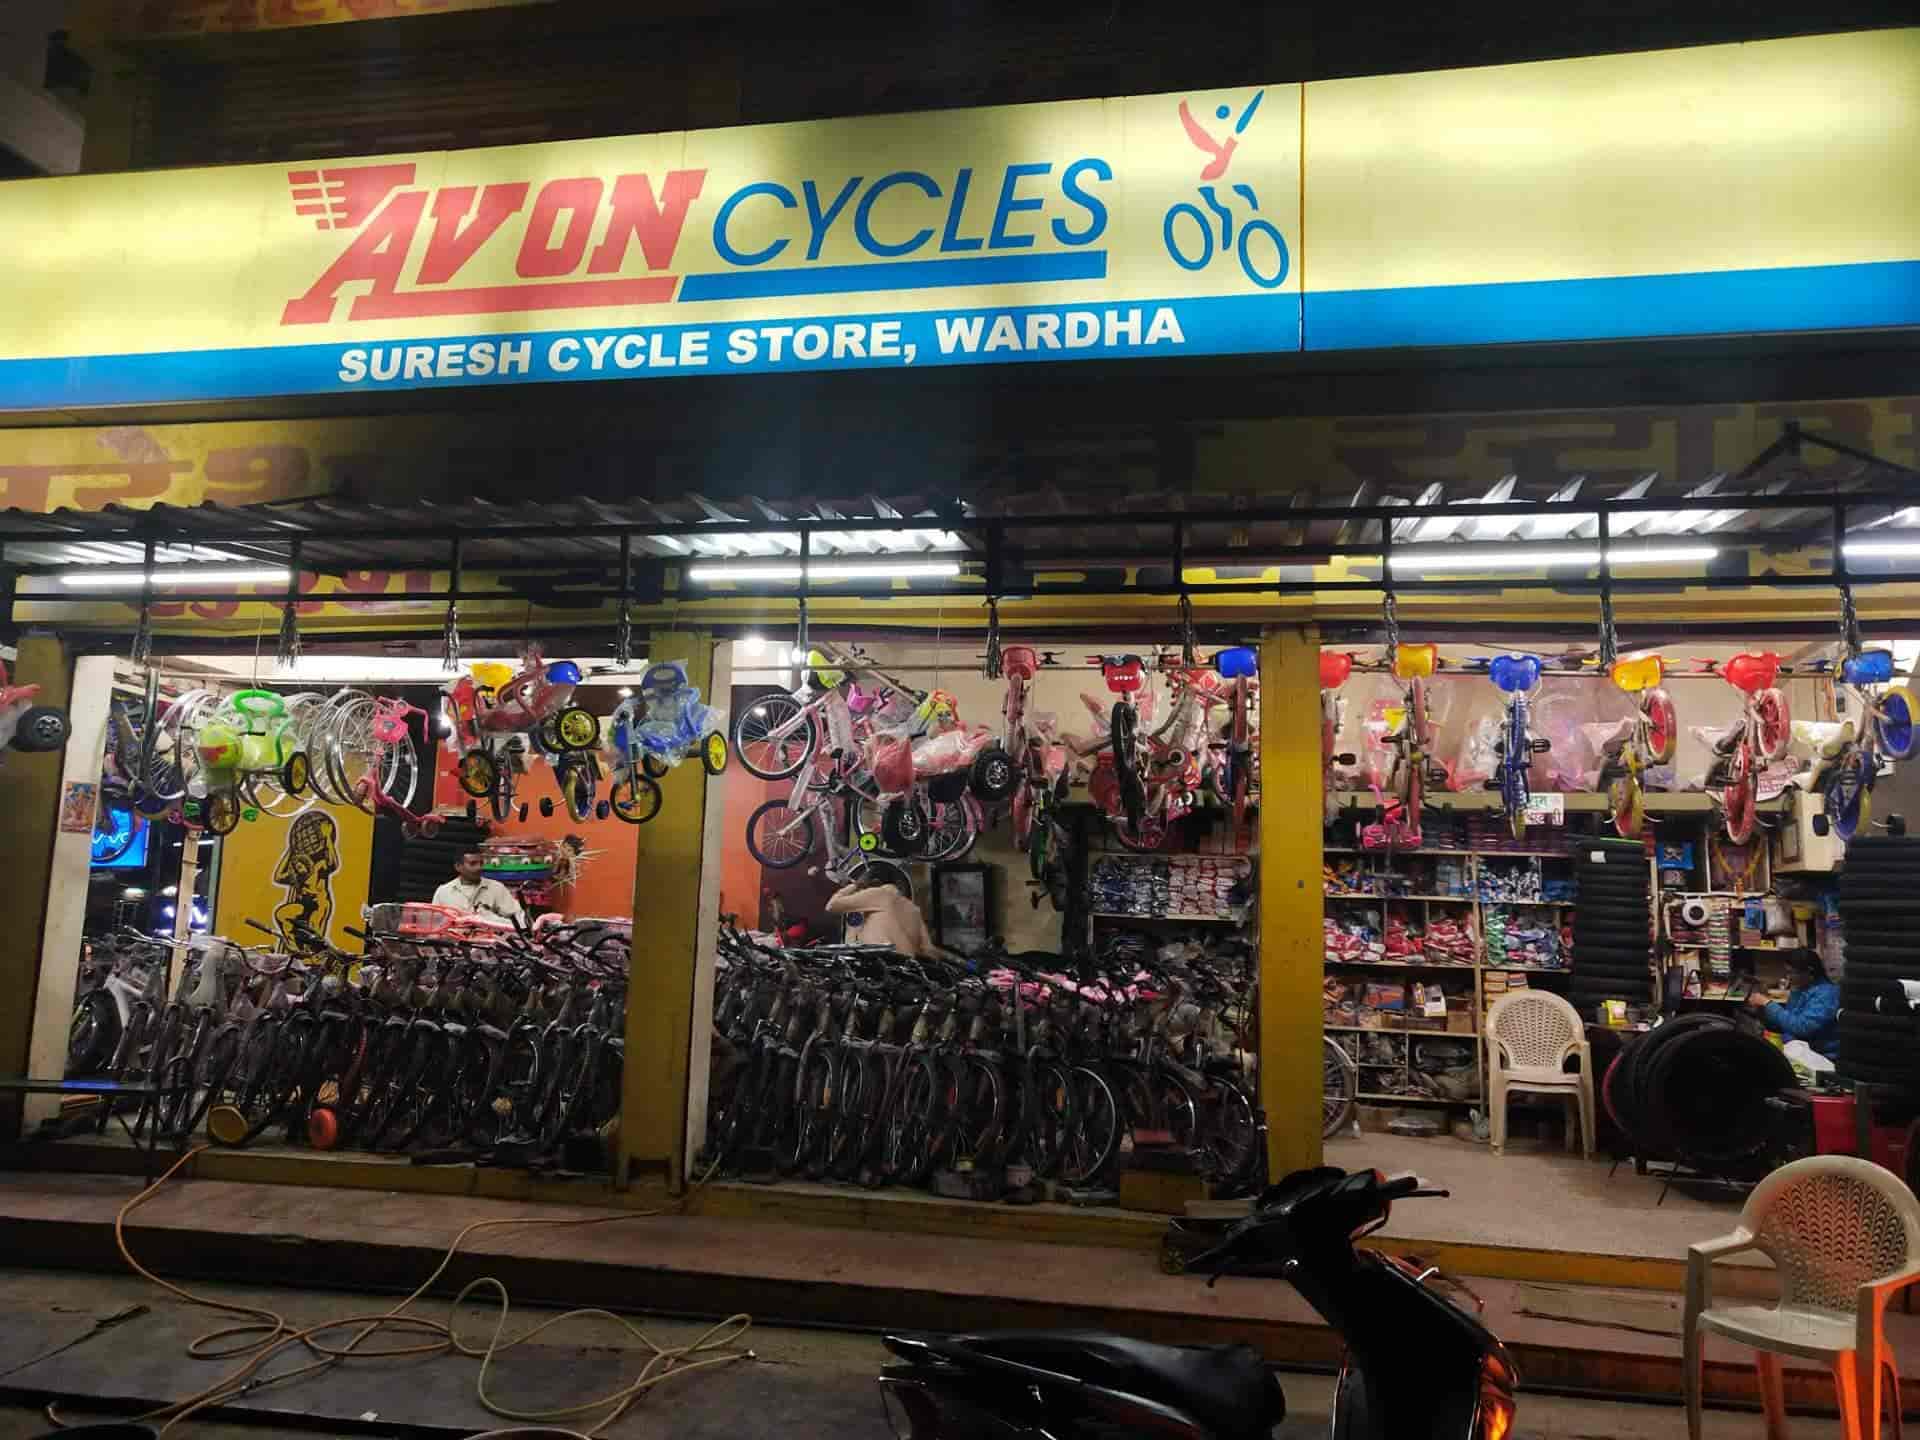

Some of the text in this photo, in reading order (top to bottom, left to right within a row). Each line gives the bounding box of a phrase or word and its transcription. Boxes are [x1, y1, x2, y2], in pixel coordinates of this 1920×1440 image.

[280, 157, 1113, 325] AVON CYCLES
[338, 307, 1185, 383] SURESH CYCLE STORE, WARDHA
